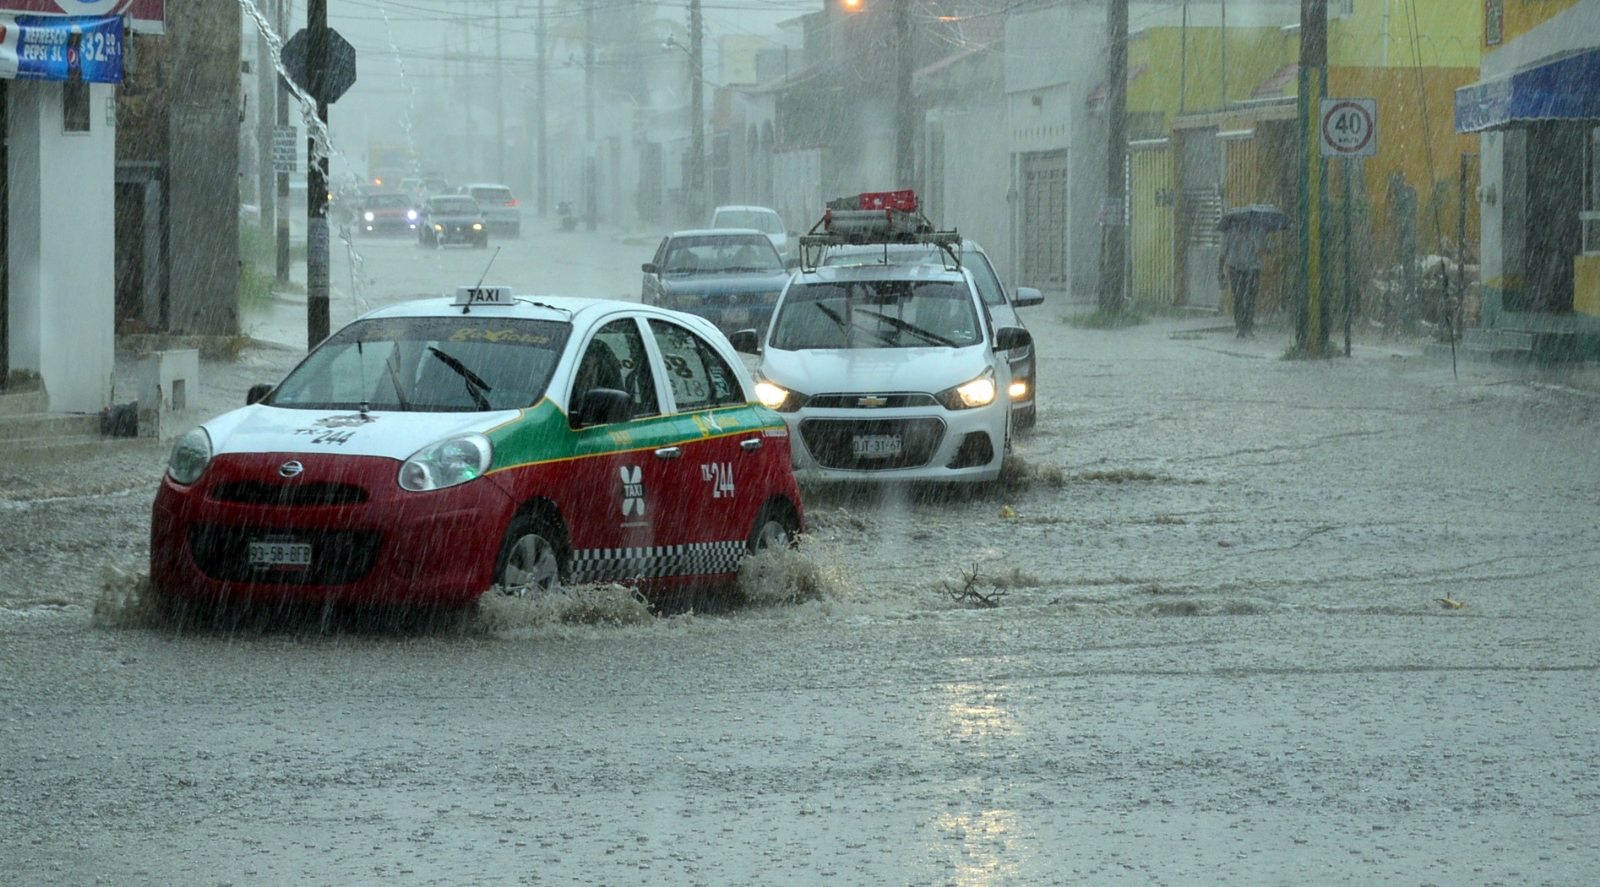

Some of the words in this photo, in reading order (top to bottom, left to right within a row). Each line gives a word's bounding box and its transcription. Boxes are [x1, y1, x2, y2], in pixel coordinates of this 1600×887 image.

[24, 44, 48, 60] PEPSI
[51, 45, 62, 61] 3L
[1335, 112, 1361, 134] 40
[467, 289, 499, 302] TAXI
[624, 484, 644, 497] TAXI
